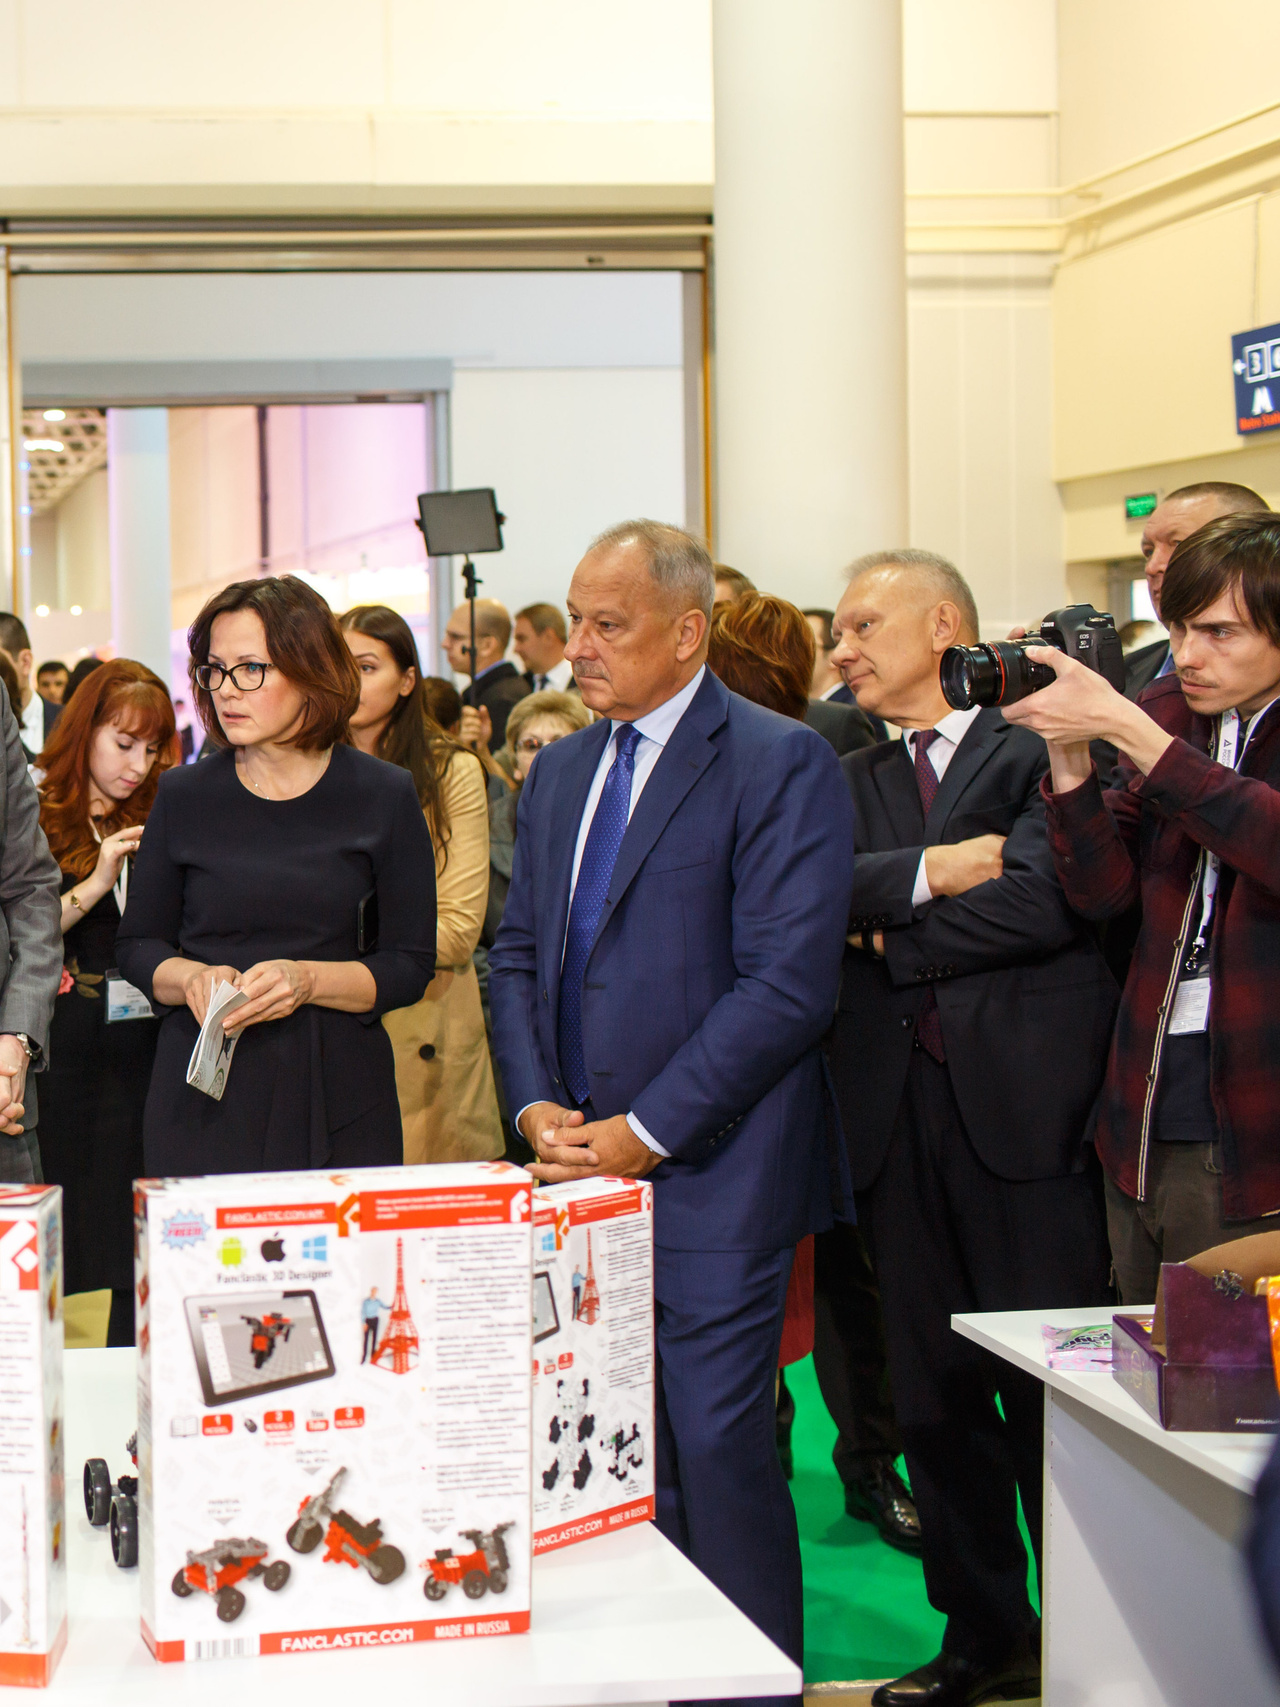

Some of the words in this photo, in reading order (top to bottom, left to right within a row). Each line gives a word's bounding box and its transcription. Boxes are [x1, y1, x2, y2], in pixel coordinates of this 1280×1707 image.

[281, 1628, 414, 1652] FANCLASTIC.COM
[435, 1623, 462, 1639] MADE
[463, 1622, 475, 1636] IN
[476, 1620, 510, 1636] RUSSIA
